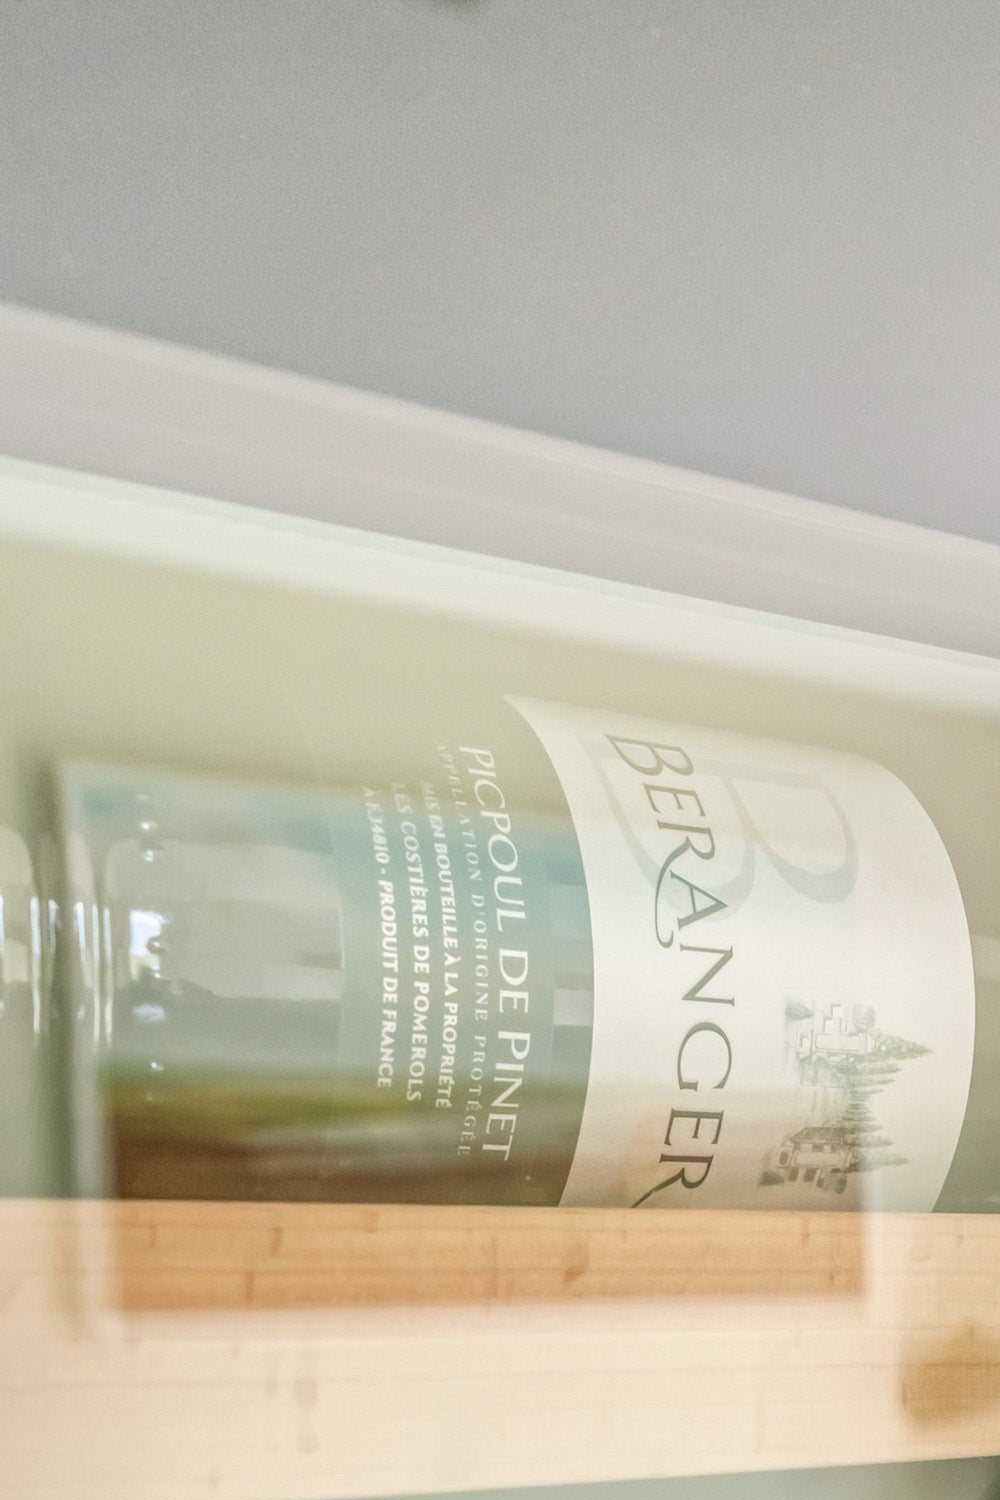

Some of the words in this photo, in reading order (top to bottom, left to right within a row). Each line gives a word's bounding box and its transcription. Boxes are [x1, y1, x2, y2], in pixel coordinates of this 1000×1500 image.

[391, 781, 413, 815] LES
[422, 781, 440, 813] MIS
[429, 812, 447, 840] EN
[437, 743, 483, 882] APPELLATION
[458, 745, 527, 933] PICPOUL
[377, 879, 400, 973] PRODUIT
[400, 820, 430, 940] COSTIÈRES
[434, 841, 460, 949] BOUTEILLE
[382, 976, 399, 1004] DE
[413, 944, 431, 974] DE
[443, 951, 462, 968] À
[443, 969, 460, 997] LA
[471, 893, 490, 1022] D'ORIGINE
[498, 949, 530, 1014] DE
[604, 733, 736, 1209] BERANGER
[377, 1008, 399, 1089] FRANCE
[406, 979, 431, 1102] POMEROLS
[435, 1002, 460, 1109] PROPRIÉTÉ
[457, 1035, 487, 1157] PROTÉGÉE
[481, 1030, 532, 1161] PINET
